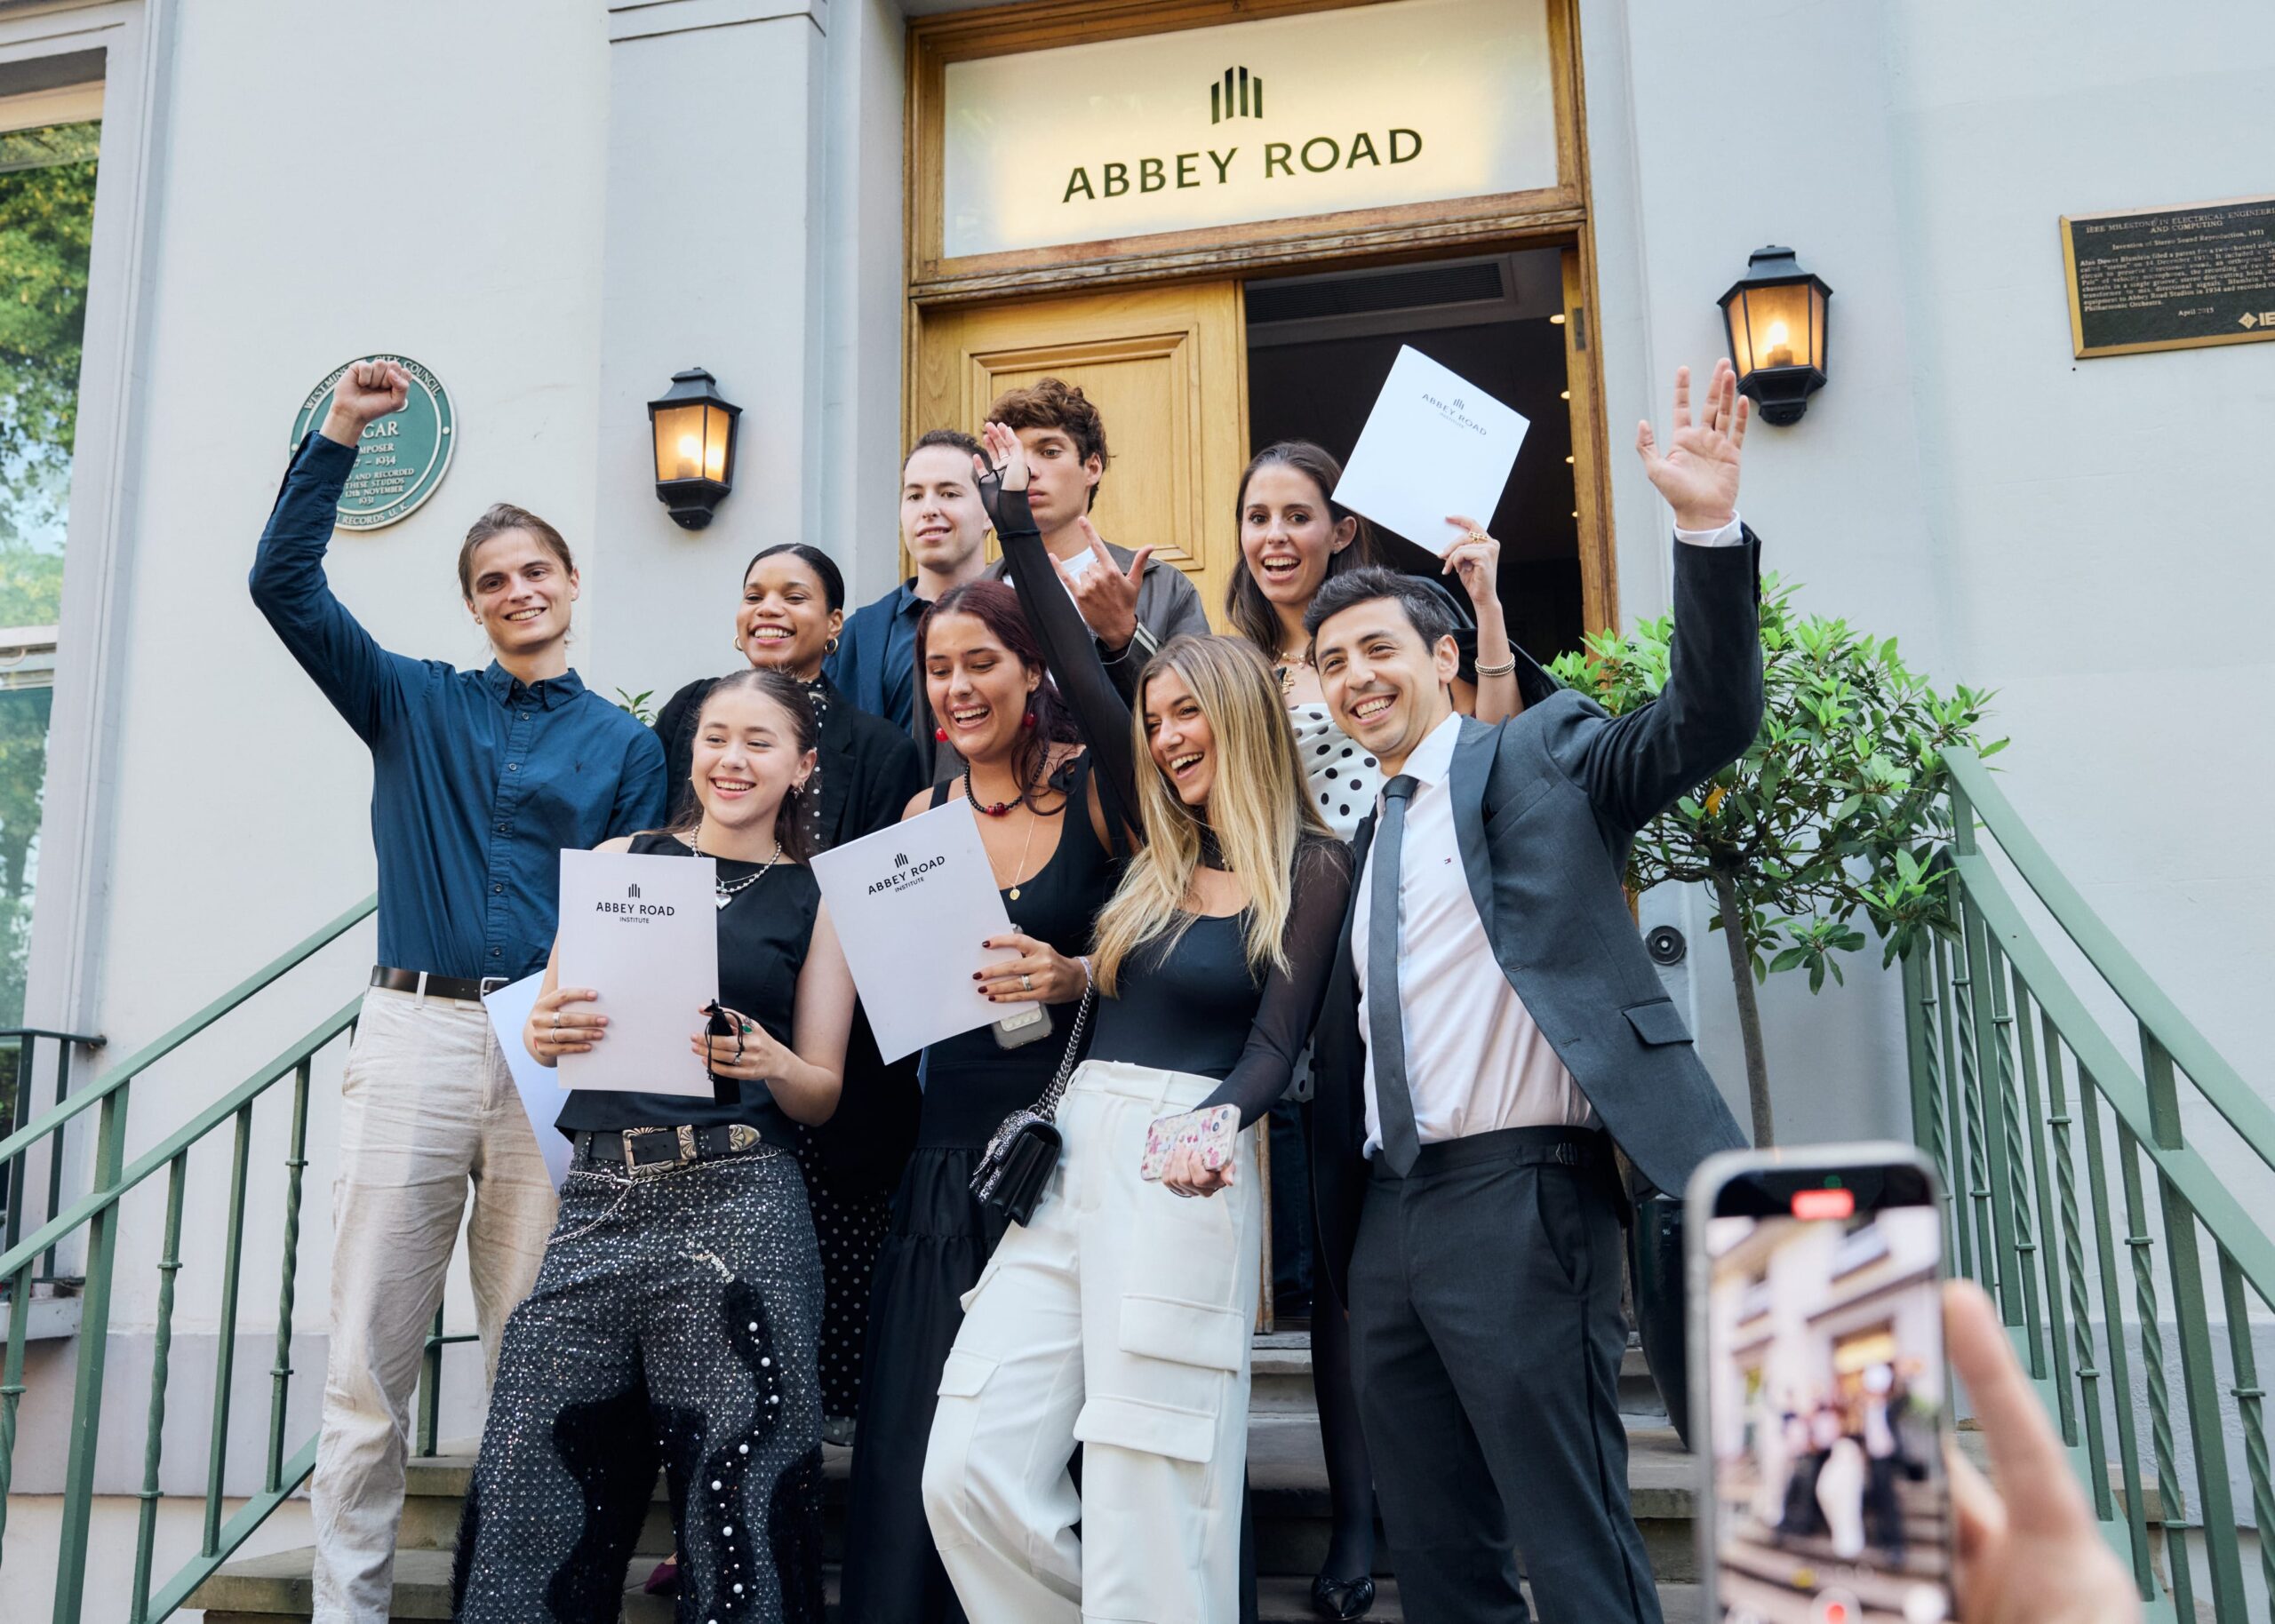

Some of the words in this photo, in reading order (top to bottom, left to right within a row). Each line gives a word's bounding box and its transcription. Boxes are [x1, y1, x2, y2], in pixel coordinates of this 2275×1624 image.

[1062, 147, 1239, 203] ABBEY
[1265, 128, 1423, 179] ROAD
[2087, 224, 2106, 234] IEEE
[2109, 219, 2158, 232] MILESTONE
[2172, 213, 2224, 225] ELECTRICAL
[2150, 225, 2168, 234] AND
[2172, 220, 2223, 231] COMPUTING
[2112, 242, 2144, 251] Invention
[2177, 235, 2198, 244] Sound
[2248, 228, 2264, 237] 1931
[2080, 259, 2095, 267] Alan
[2178, 307, 2196, 317] April
[403, 361, 442, 398] COUNCIL
[1422, 394, 1456, 416] ABBEY
[1458, 414, 1487, 435] ROAD
[362, 420, 399, 439] GAR
[359, 442, 395, 455] MPOSER
[376, 456, 396, 466] 1934
[355, 473, 371, 482] AND
[374, 468, 415, 479] RECORDED
[345, 481, 369, 490] THESE
[371, 477, 405, 487] STUDIOS
[363, 485, 404, 498] NOVEMBER
[342, 513, 385, 525] RECORDS
[868, 872, 906, 895] ABBEY
[910, 856, 946, 876] ROAD
[895, 877, 924, 893] INSTITUTE
[596, 902, 635, 914] ABBEY
[640, 904, 675, 916] ROAD
